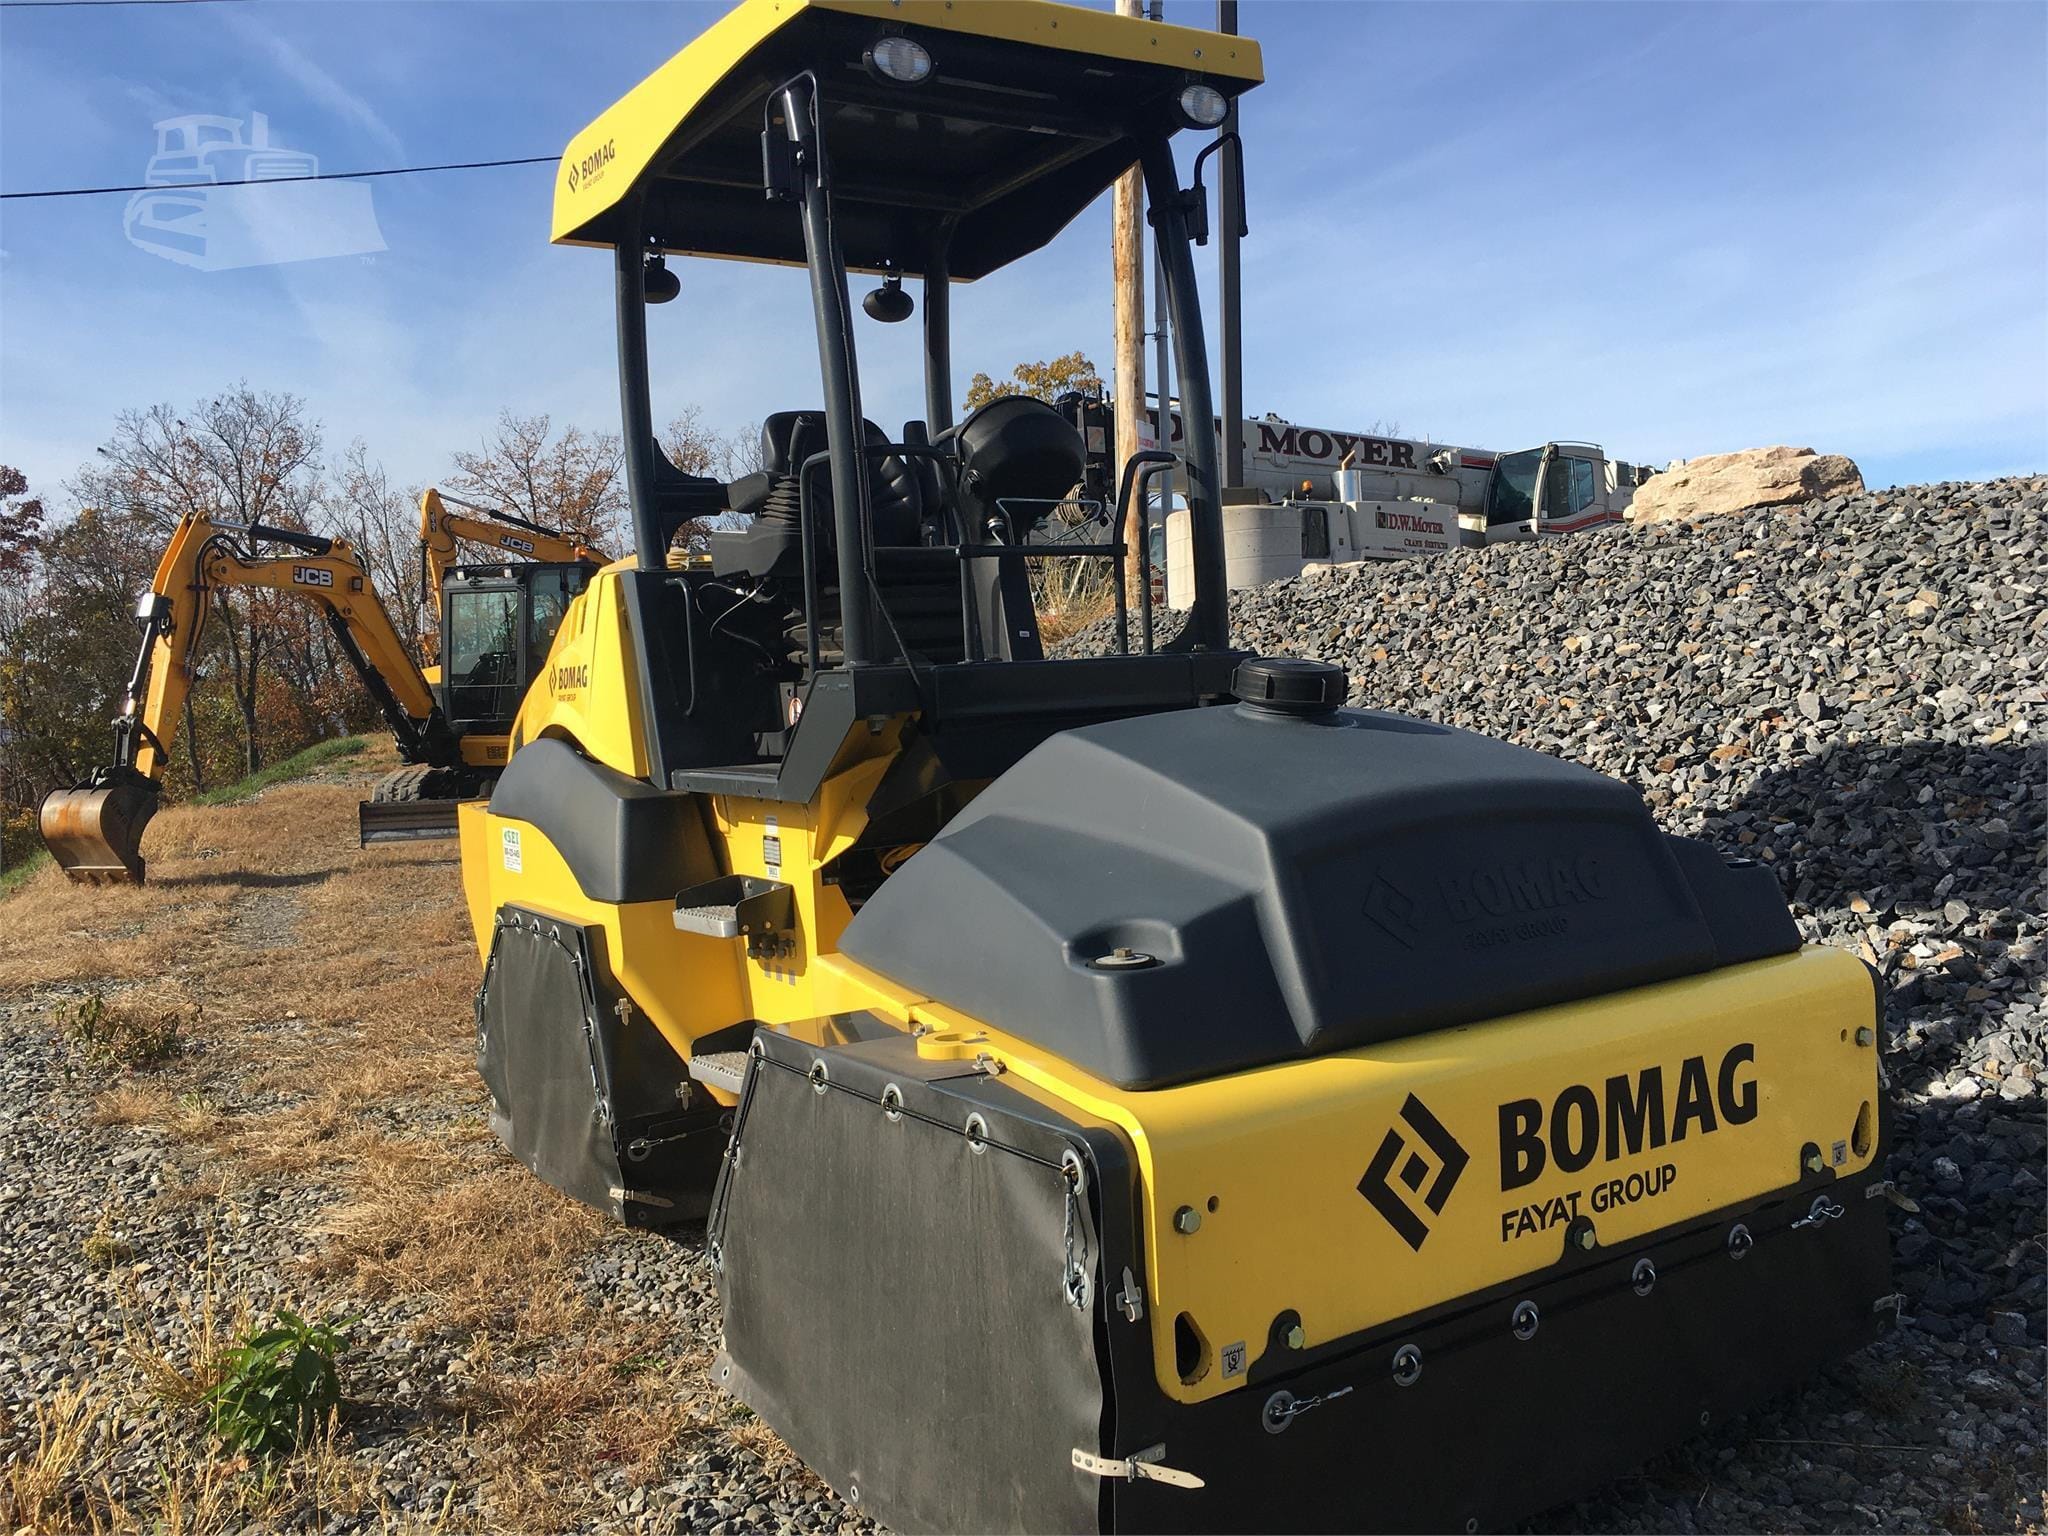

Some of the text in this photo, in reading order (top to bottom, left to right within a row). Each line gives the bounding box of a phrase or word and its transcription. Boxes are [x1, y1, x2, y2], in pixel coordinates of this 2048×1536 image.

[581, 138, 615, 181] BOMAG
[1256, 423, 1418, 470] MOYER
[500, 535, 534, 553] JCB
[293, 567, 333, 586] JCB
[558, 664, 588, 690] BOMAG
[1434, 855, 1607, 924] BOMAG
[1498, 1042, 1758, 1193] BOMAG
[1501, 1163, 1677, 1243] FAYAT GROUP
